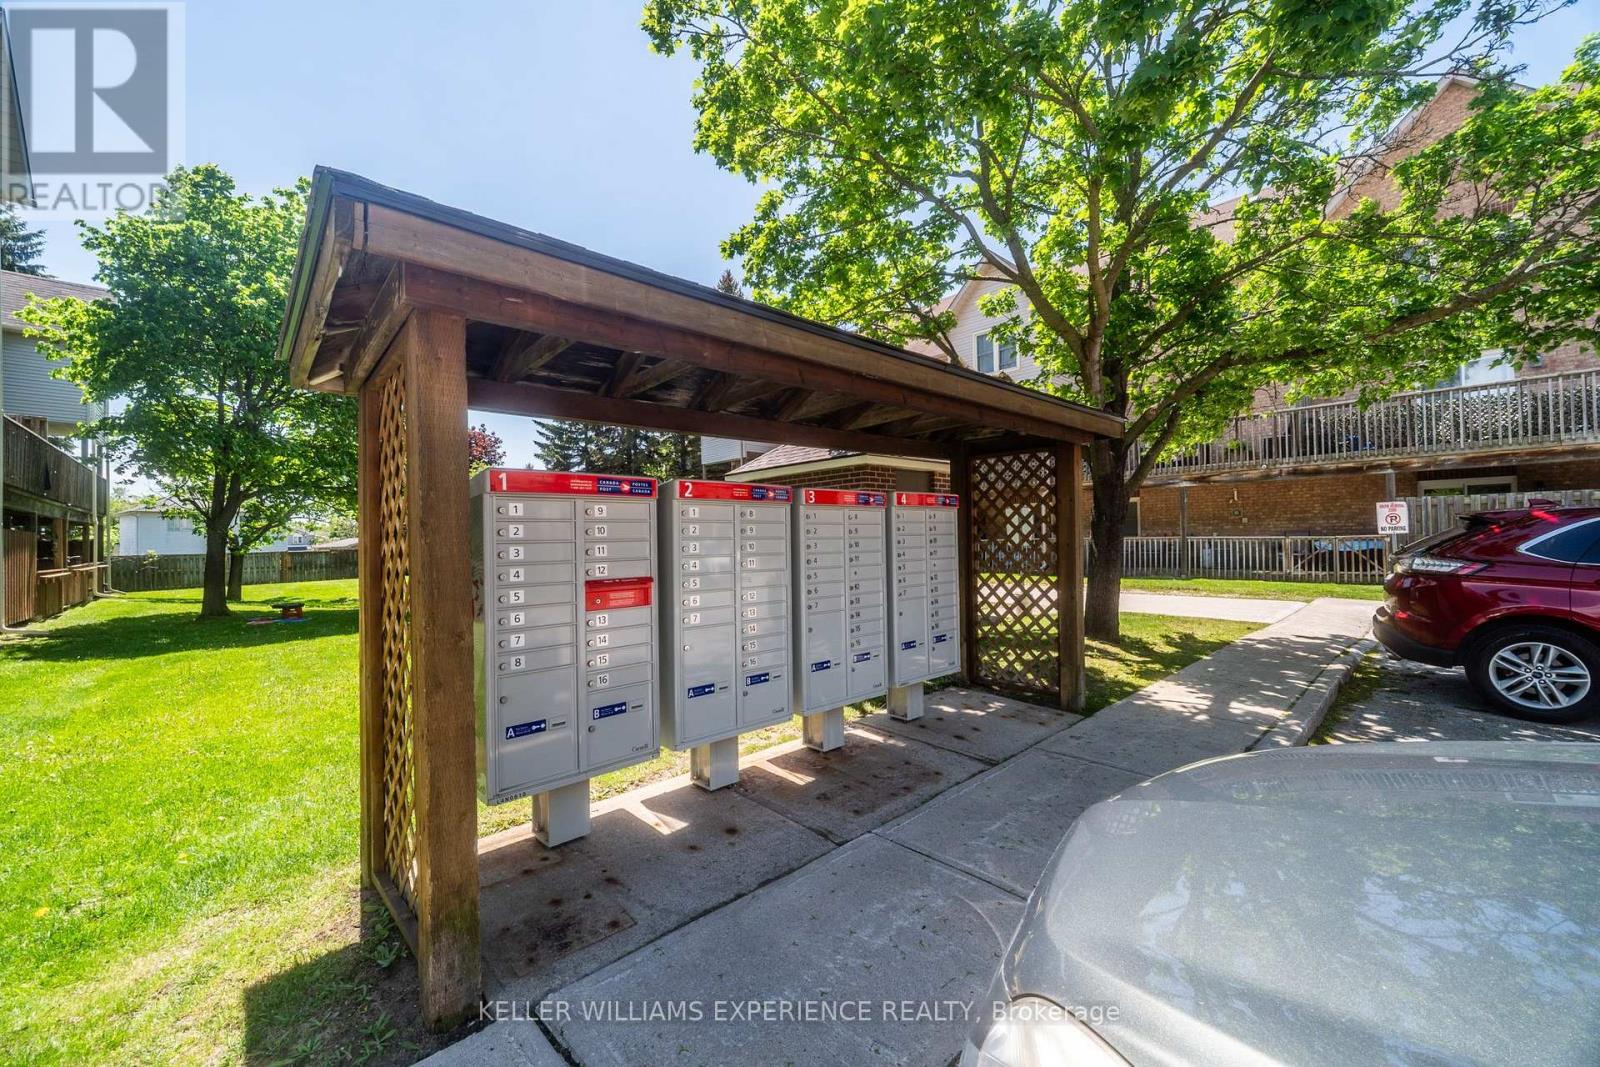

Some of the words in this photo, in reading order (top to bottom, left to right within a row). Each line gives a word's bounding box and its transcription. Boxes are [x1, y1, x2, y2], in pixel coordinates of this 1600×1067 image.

[498, 472, 507, 491] 1
[684, 482, 693, 497] 2
[808, 491, 815, 503] 3
[901, 493, 907, 504] 4
[513, 505, 518, 514] 1
[598, 507, 603, 515] 9
[749, 510, 754, 518] 8
[513, 527, 520, 535] 2
[597, 527, 605, 535] 10
[513, 548, 520, 557] 3
[597, 547, 605, 555] 11
[513, 570, 520, 579] 4
[597, 566, 606, 575] 12
[514, 592, 520, 601] 5
[514, 614, 520, 623] 6
[598, 616, 606, 624] 13
[514, 636, 521, 645] 7
[598, 636, 607, 644] 14
[515, 658, 521, 667] 8
[598, 655, 607, 664] 15
[598, 675, 607, 684] 16
[746, 677, 751, 685] B
[688, 689, 694, 698] A
[593, 709, 600, 719] B
[506, 727, 515, 738] A
